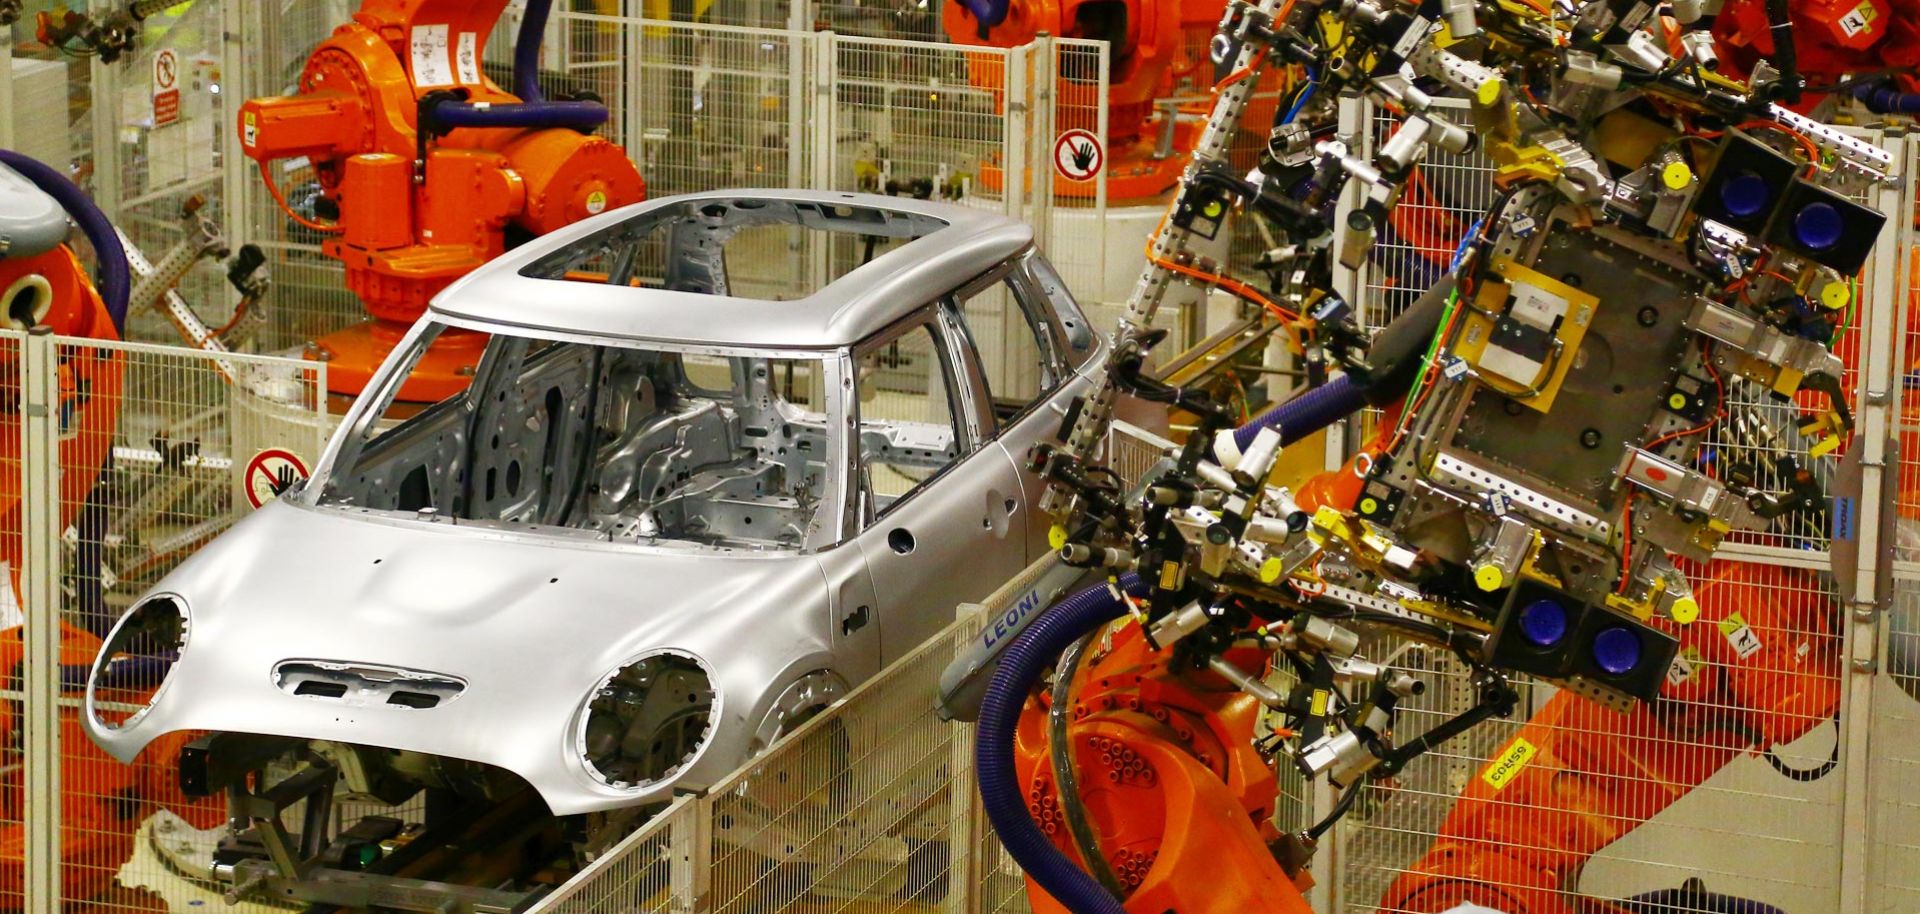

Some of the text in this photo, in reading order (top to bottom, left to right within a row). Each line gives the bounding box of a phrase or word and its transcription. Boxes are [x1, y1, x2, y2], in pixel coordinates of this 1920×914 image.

[1840, 496, 1848, 538] TROAX
[982, 589, 1040, 648] LEONI
[1490, 744, 1528, 781] 6SR03
